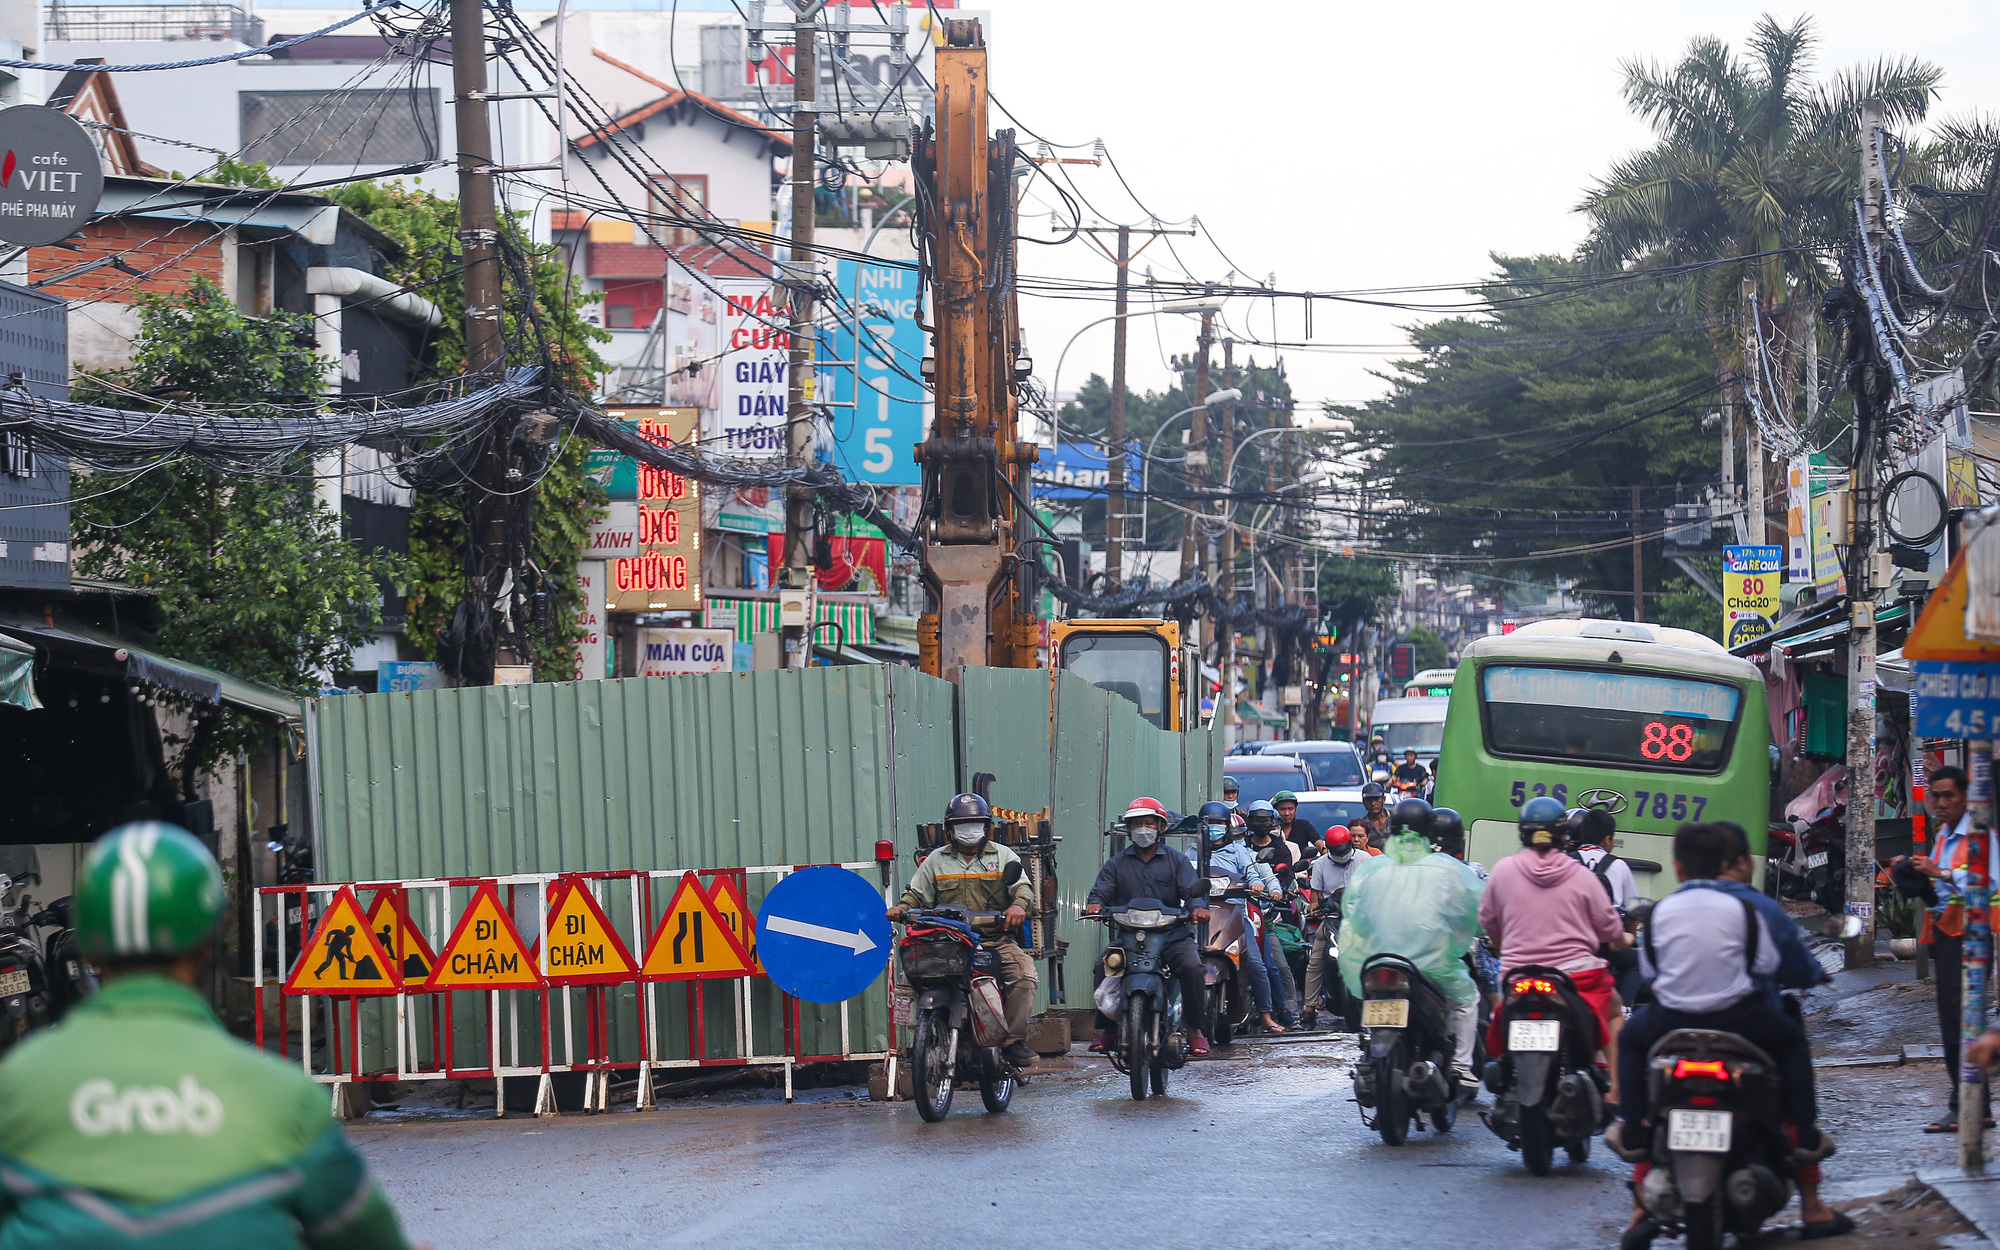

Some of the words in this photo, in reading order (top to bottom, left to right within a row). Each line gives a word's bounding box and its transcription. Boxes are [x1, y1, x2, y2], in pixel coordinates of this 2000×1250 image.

[32, 151, 68, 166] cafe
[18, 169, 83, 193] VIET
[1, 200, 24, 217] PHÊ
[26, 203, 49, 218] PHA
[51, 201, 76, 219] MÁY
[861, 268, 902, 290] NHI
[736, 354, 789, 384] GIẤY
[738, 390, 785, 417] DÁN
[592, 527, 634, 549] XÍNH
[614, 550, 689, 593] CHỨNG
[1742, 577, 1765, 596] 80
[646, 639, 686, 662] MÀN
[691, 637, 725, 663] CỬA
[390, 675, 412, 692] SỐ
[1491, 667, 1522, 699] BẾN
[1631, 682, 1672, 709] LONG
[1944, 709, 1986, 739] 4,5
[1640, 721, 1694, 763] 88
[1634, 789, 1708, 822] 7857
[475, 919, 498, 941] ĐI
[564, 914, 586, 936] ĐI
[451, 948, 518, 979] CHẬM
[550, 941, 604, 968] CHẬM
[70, 1073, 226, 1139] Grab
